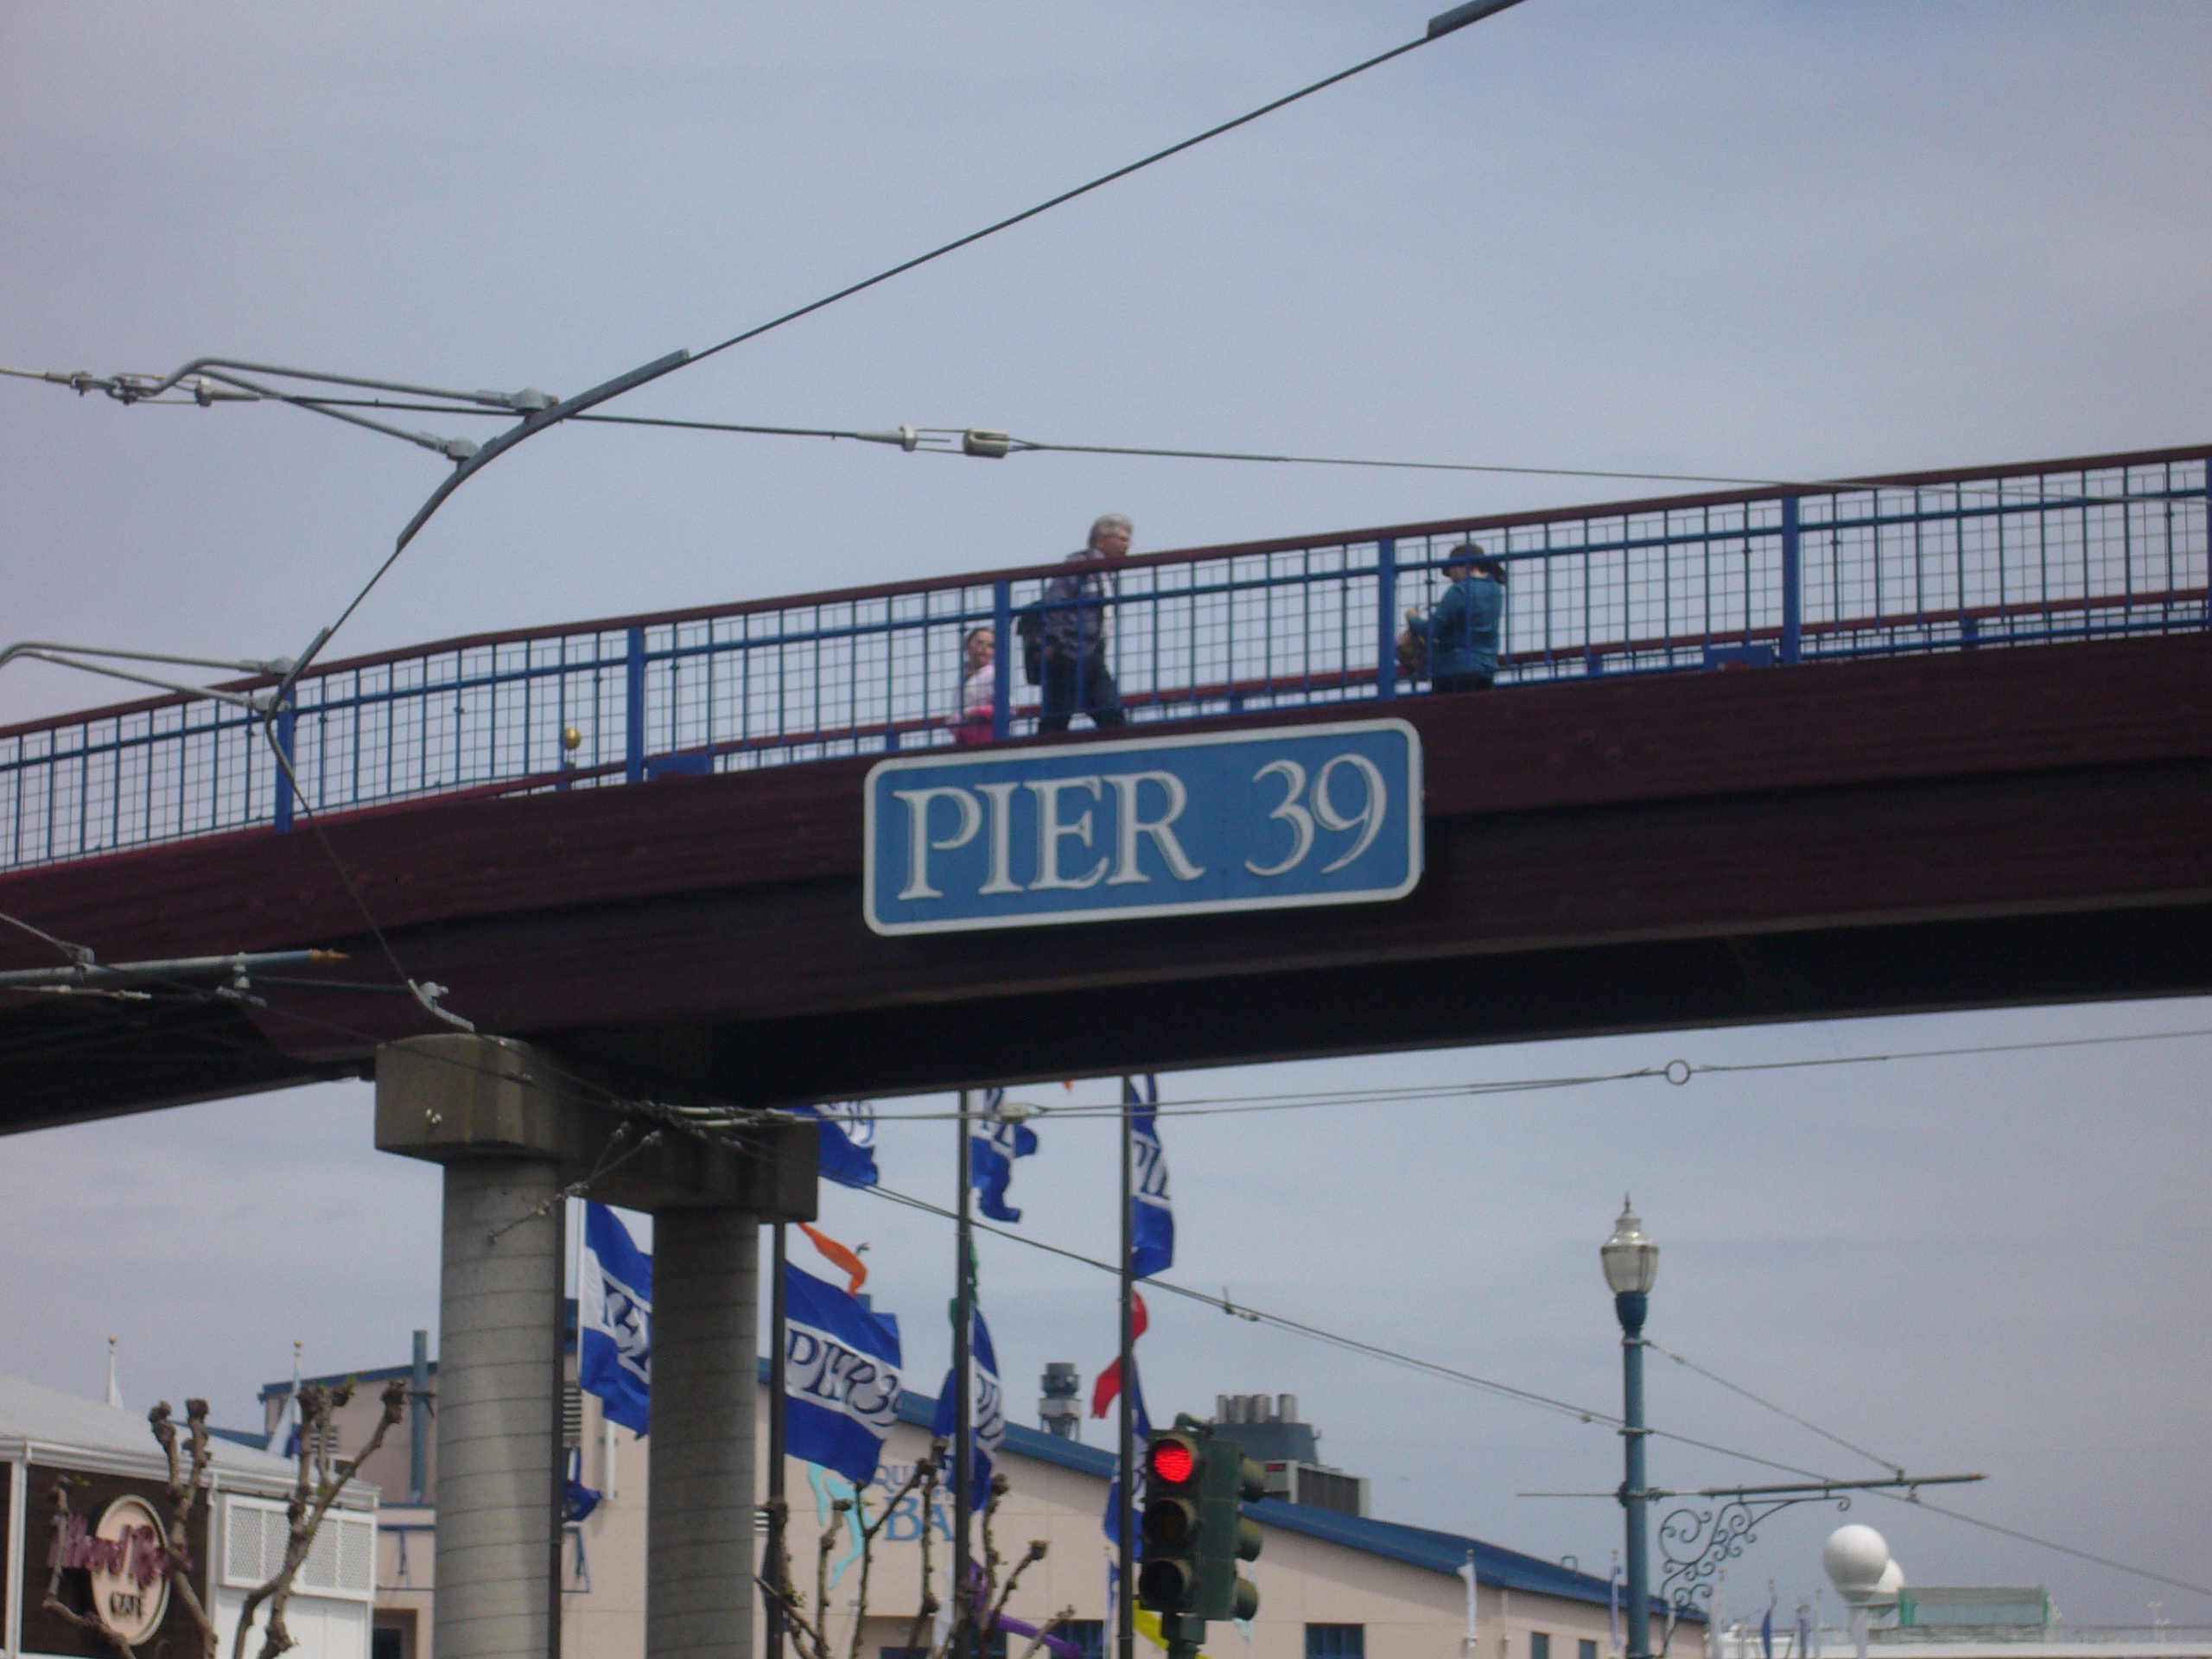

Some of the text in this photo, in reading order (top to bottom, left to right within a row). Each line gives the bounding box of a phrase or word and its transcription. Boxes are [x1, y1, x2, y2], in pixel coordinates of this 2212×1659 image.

[893, 753, 1388, 901] PIER 39
[884, 1496, 956, 1541] BA
